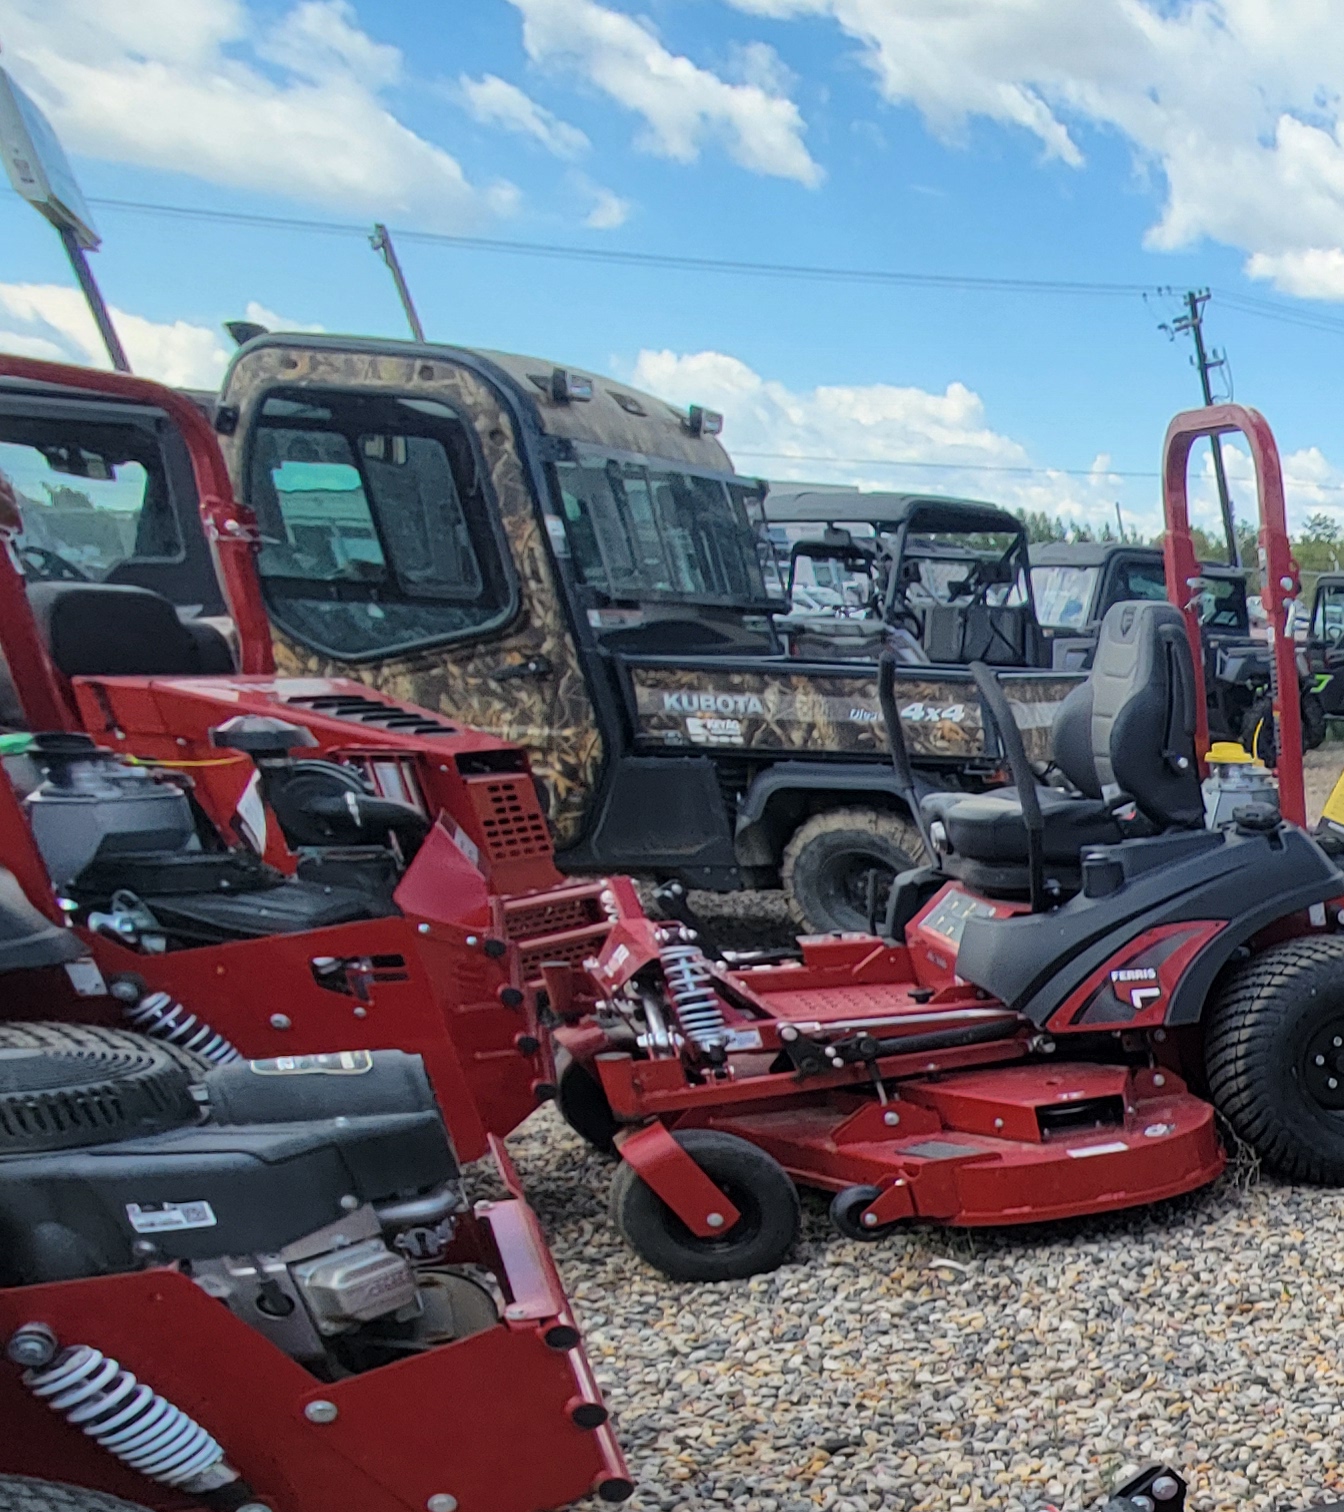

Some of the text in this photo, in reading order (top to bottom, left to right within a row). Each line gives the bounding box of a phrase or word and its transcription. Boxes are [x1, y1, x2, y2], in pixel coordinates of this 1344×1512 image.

[663, 691, 764, 715] KUBOTA
[901, 702, 965, 722] 4x4
[1110, 967, 1156, 983] FERRIS
